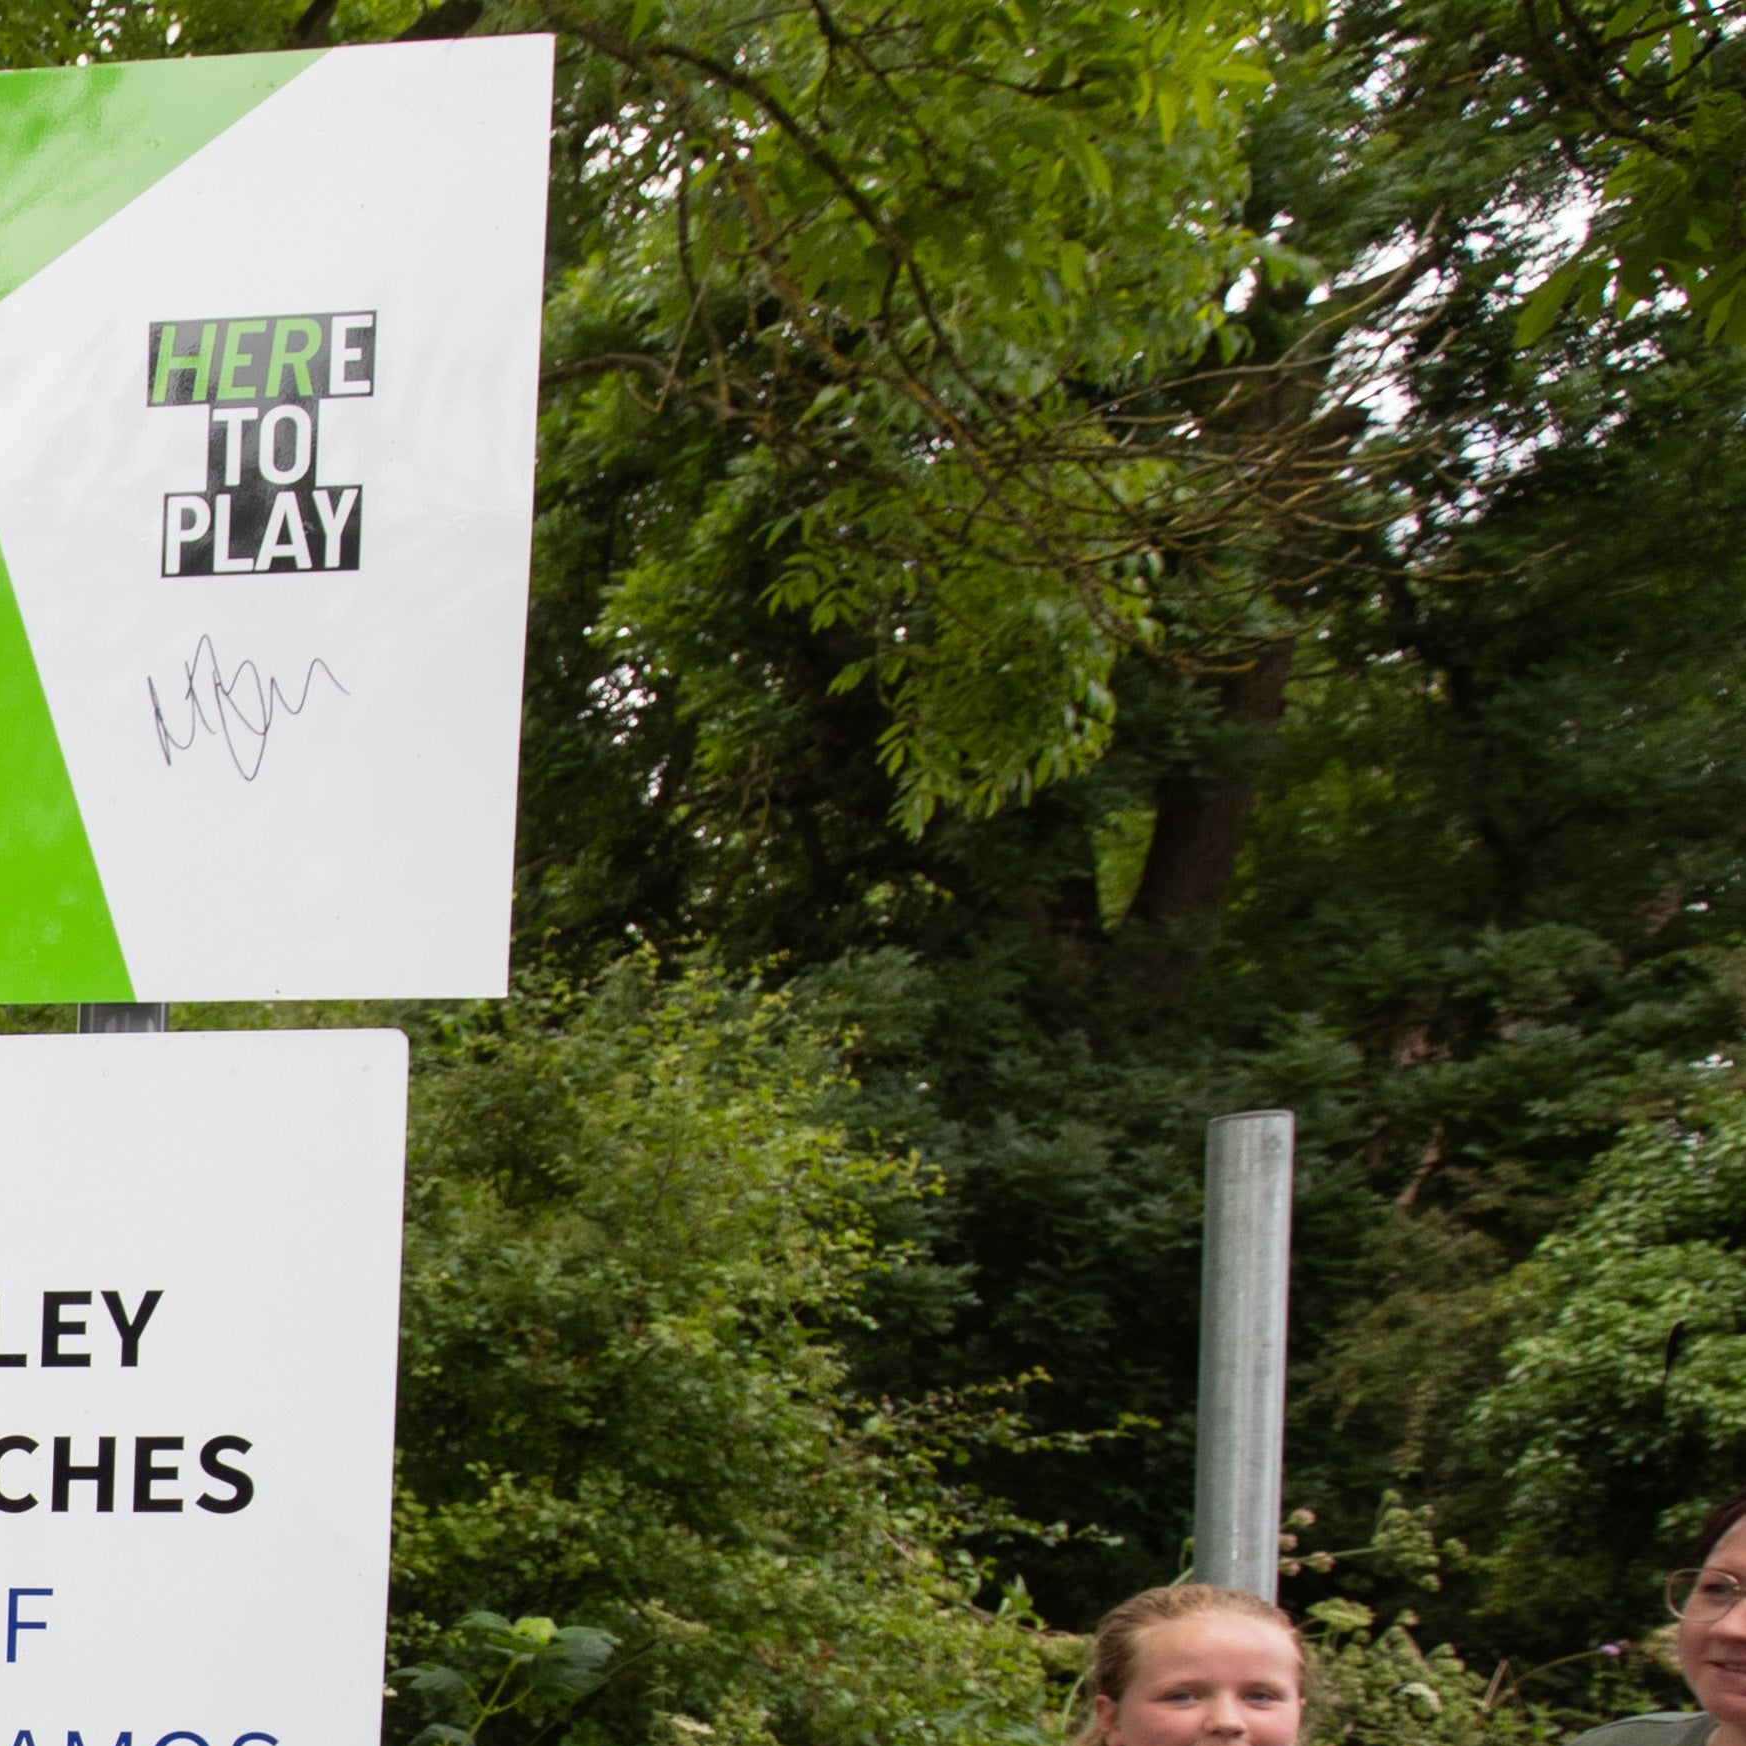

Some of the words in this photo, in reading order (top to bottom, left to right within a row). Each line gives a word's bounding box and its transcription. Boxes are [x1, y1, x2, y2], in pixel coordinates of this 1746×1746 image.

[150, 313, 374, 403] HERE
[212, 404, 312, 486] TO
[164, 488, 359, 575] PLAY
